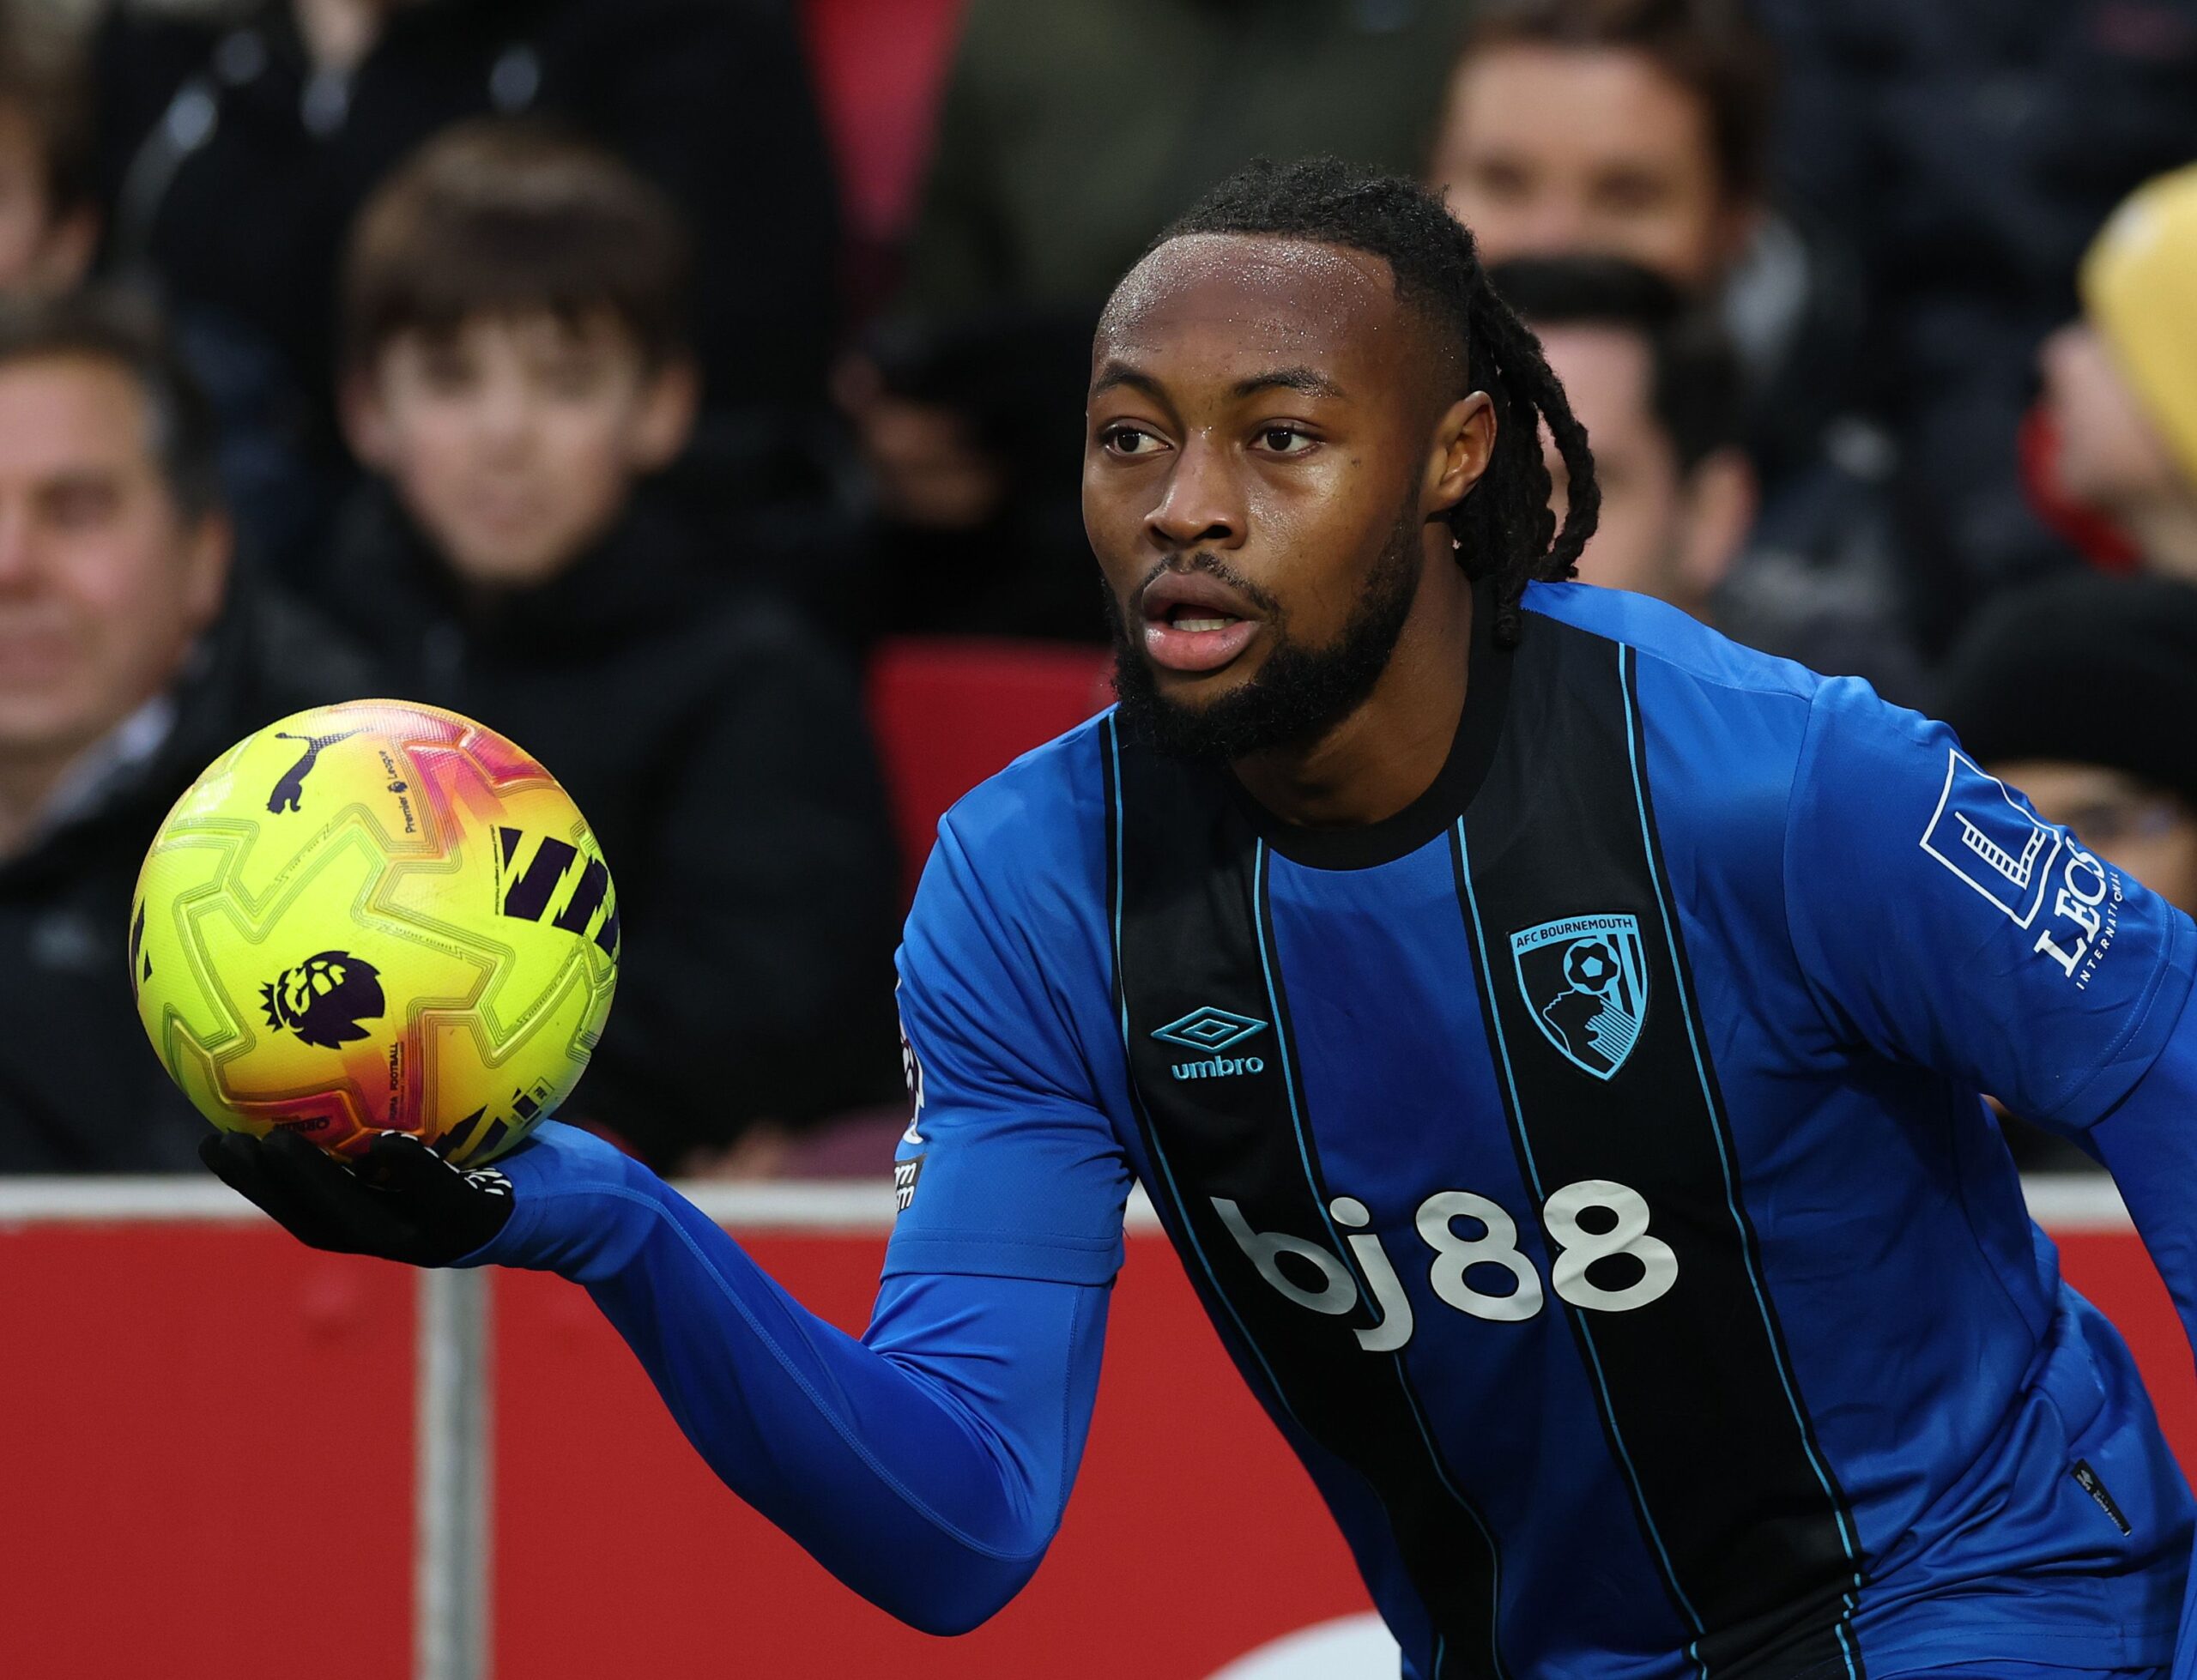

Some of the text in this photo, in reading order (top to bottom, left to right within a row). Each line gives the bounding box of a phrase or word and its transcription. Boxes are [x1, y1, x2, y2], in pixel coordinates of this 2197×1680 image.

[399, 795, 416, 833] Premier
[1516, 918, 1633, 948] AFC BOURNEMOUTH
[2075, 872, 2124, 990] INTERNATIONAL
[390, 1042, 398, 1091] FOOTBALL
[1171, 1055, 1264, 1080] umbro
[1209, 1179, 1679, 1352] bj88
